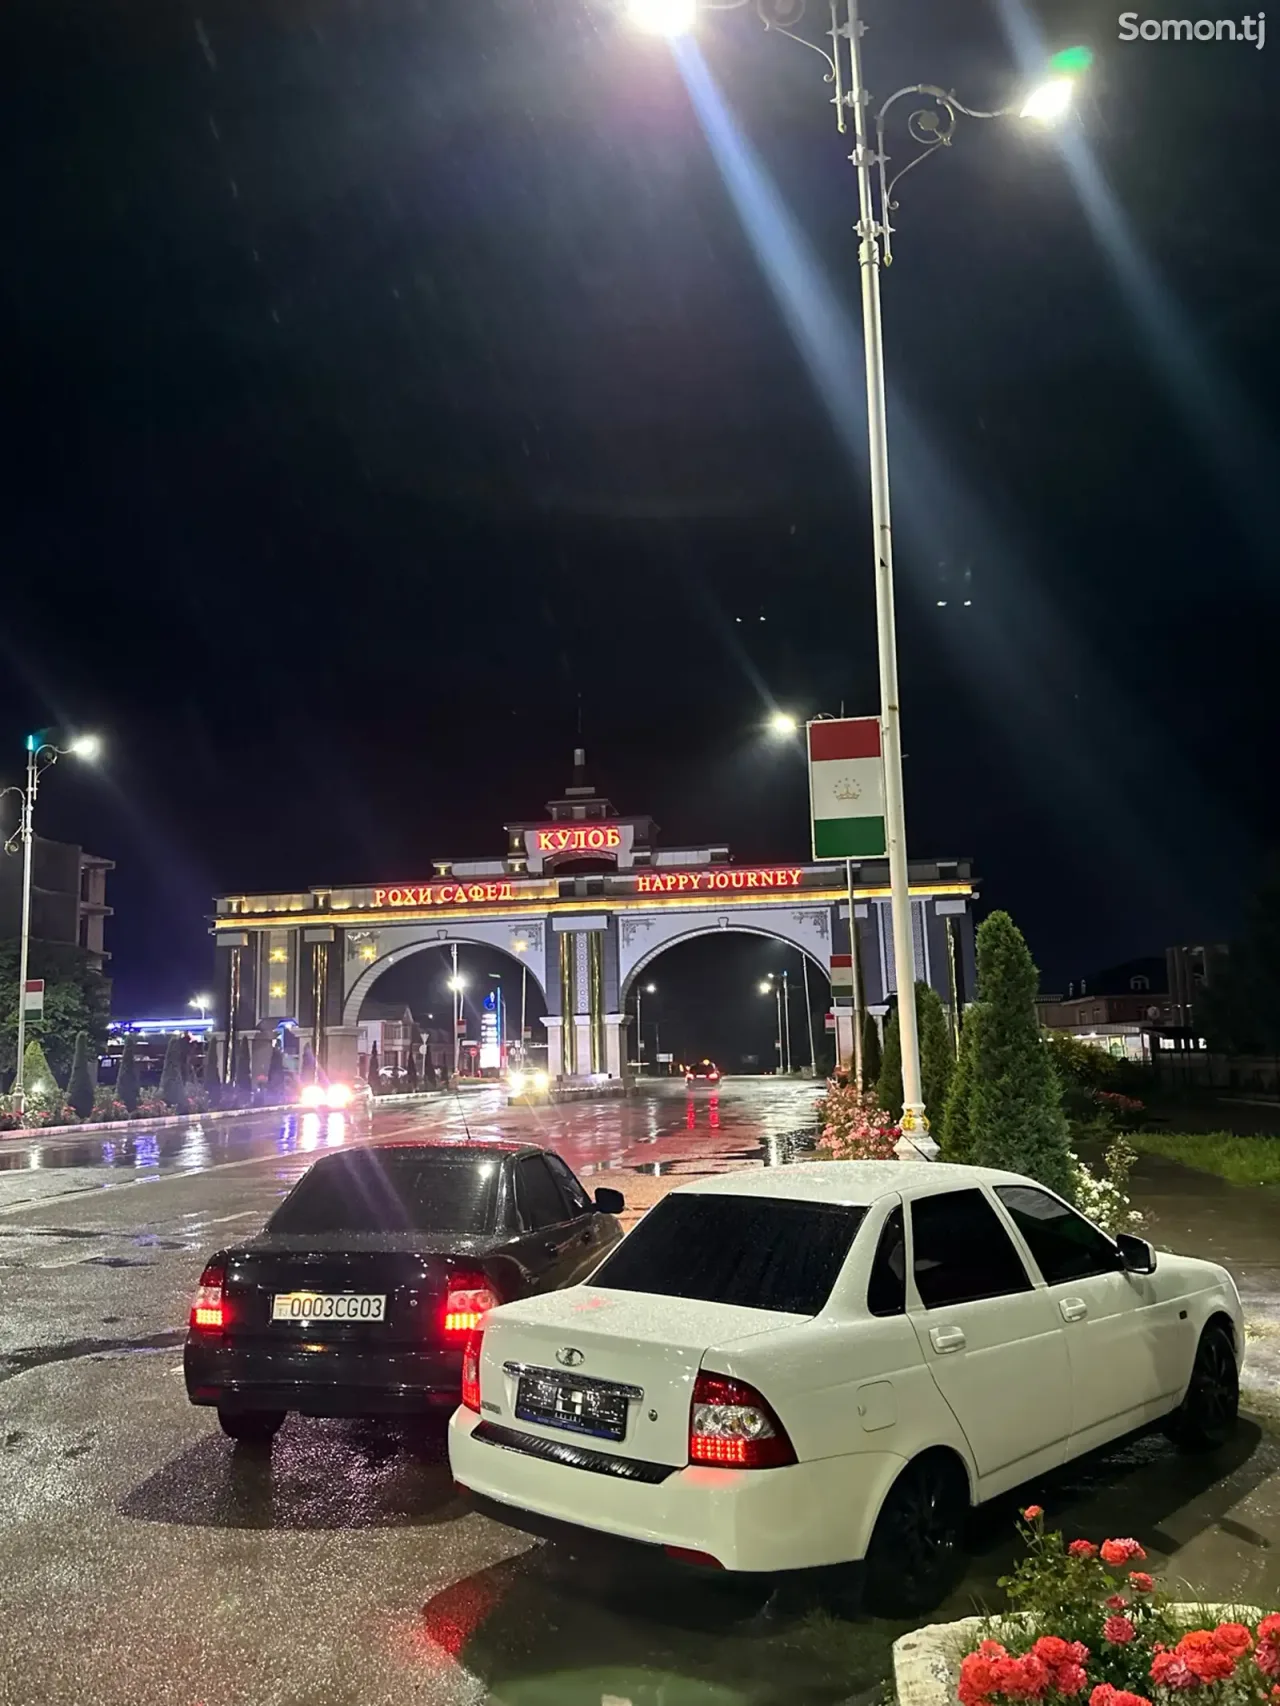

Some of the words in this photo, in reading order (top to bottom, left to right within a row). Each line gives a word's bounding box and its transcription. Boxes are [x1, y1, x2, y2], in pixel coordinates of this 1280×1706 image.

[637, 874, 702, 892] HAPPY
[707, 869, 801, 889] JOURNEY
[440, 883, 513, 903] САФЕД
[291, 1297, 382, 1318] 0003CG03
